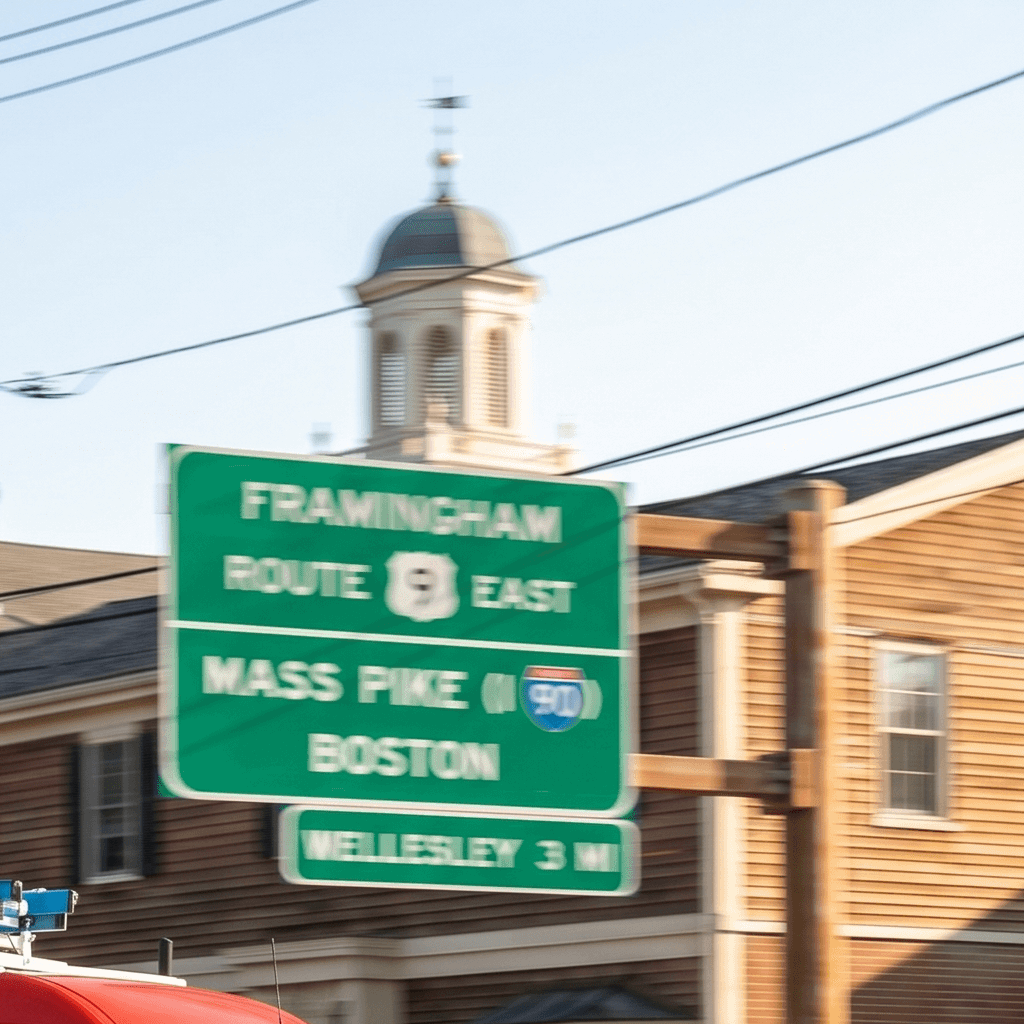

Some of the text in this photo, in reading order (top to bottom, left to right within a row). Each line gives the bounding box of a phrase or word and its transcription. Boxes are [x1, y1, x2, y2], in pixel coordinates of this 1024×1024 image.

[240, 480, 562, 543] FRAMINGHAM
[223, 553, 372, 601] ROUTE
[470, 574, 576, 614] EAST
[202, 655, 344, 702] MASS
[357, 665, 469, 710] PIKE
[307, 732, 501, 781] BOSTON
[300, 829, 524, 868] WELLESLEY
[534, 839, 568, 871] 3
